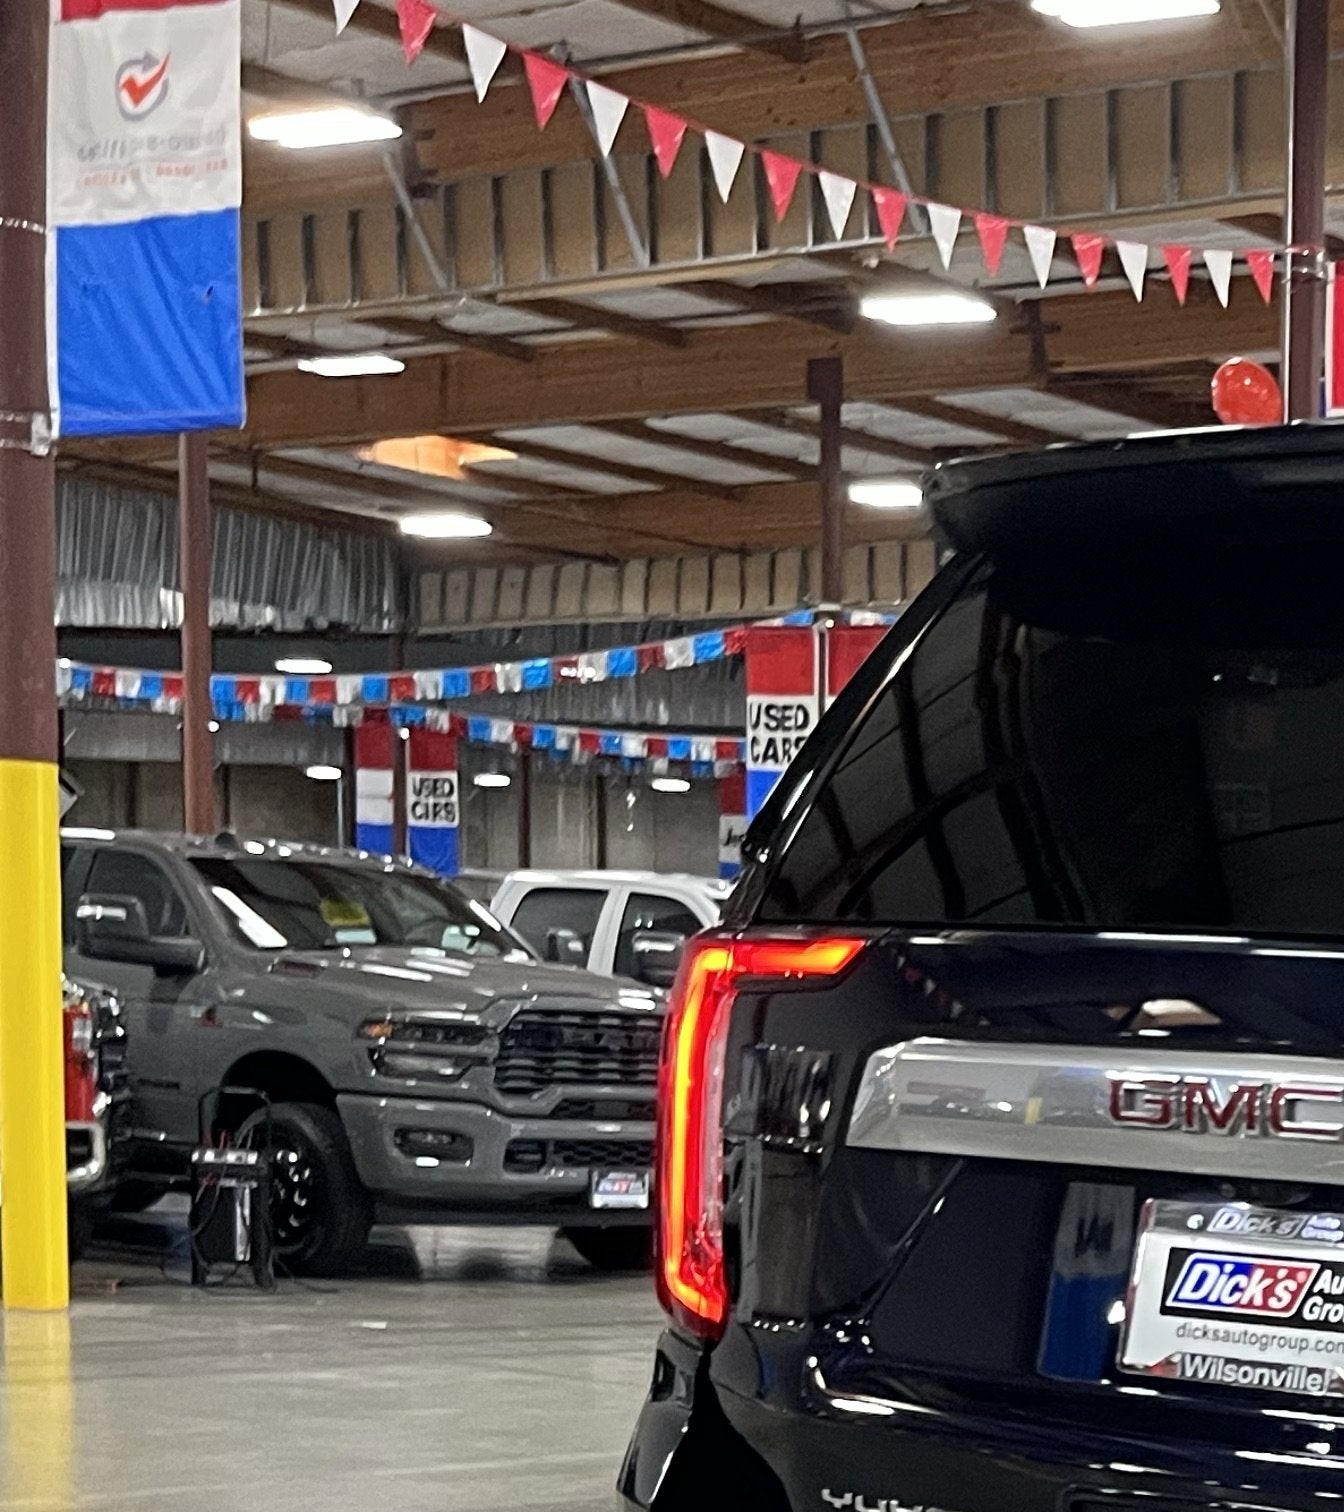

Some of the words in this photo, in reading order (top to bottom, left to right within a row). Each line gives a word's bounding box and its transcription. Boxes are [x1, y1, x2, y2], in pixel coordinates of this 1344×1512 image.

[749, 703, 810, 731] USED
[1176, 1261, 1300, 1310] Dick's
[1182, 1353, 1324, 1393] Wilsonville
